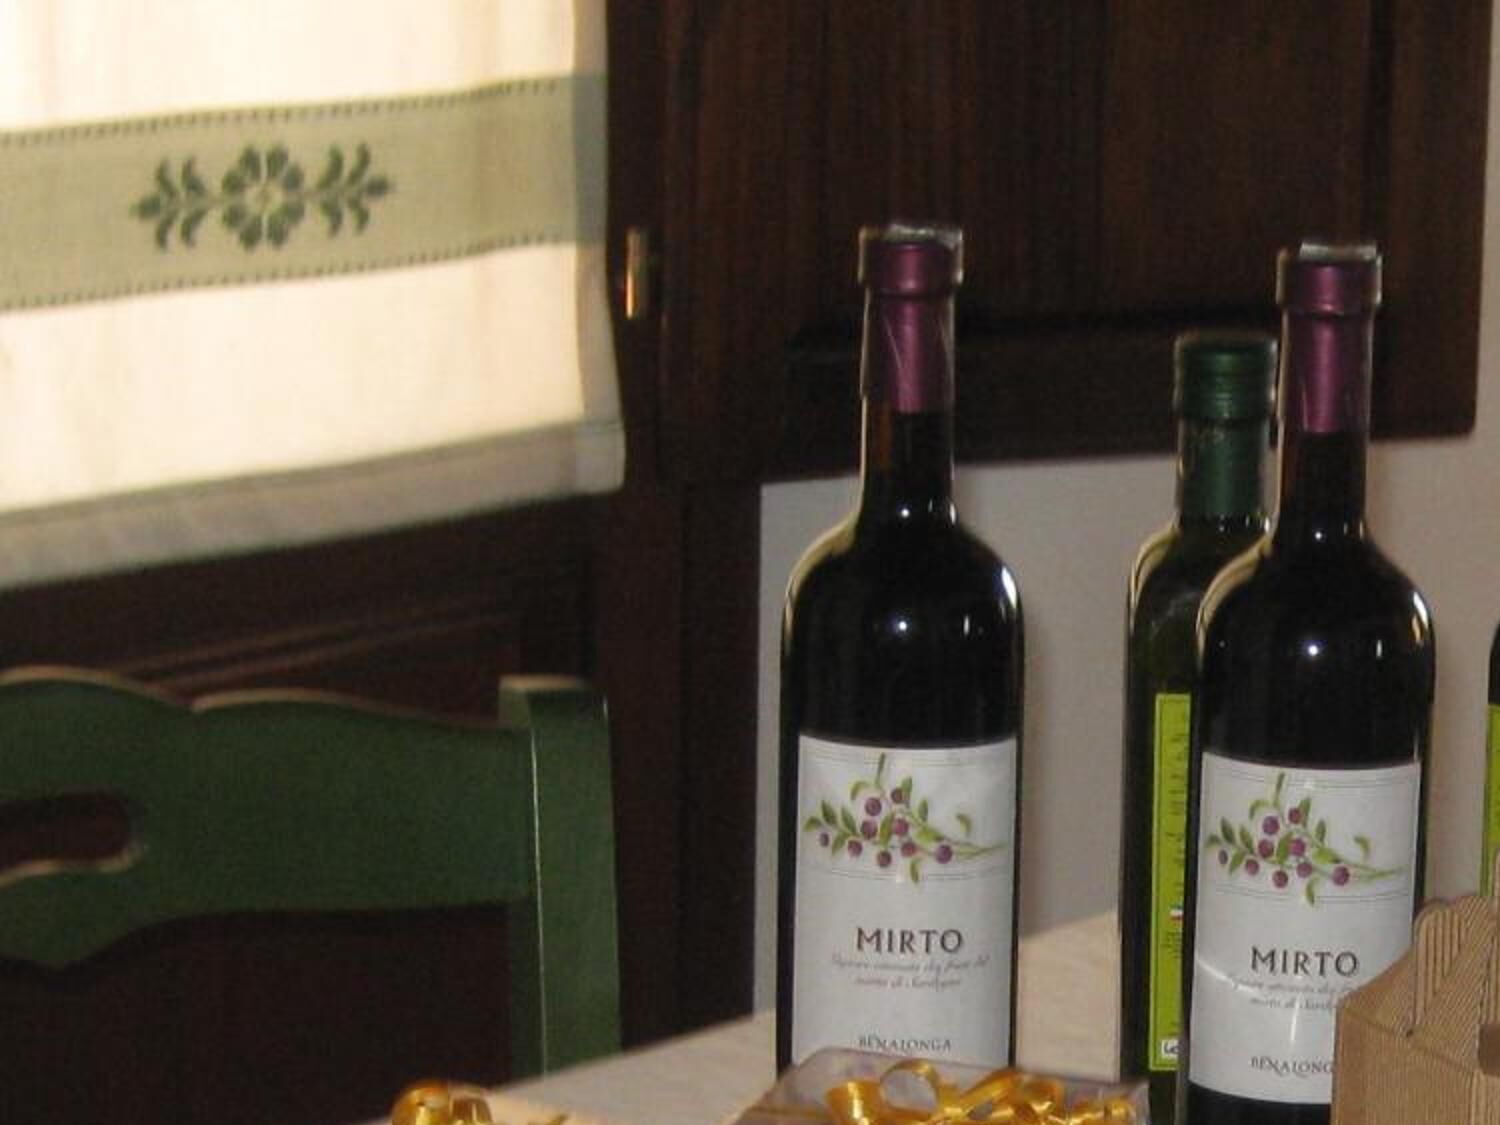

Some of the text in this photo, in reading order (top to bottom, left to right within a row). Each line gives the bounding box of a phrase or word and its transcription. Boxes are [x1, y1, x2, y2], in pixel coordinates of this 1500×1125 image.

[856, 926, 964, 954] MIRTO
[1251, 946, 1359, 977] MIRTO
[1251, 1056, 1333, 1078] BENALONG
